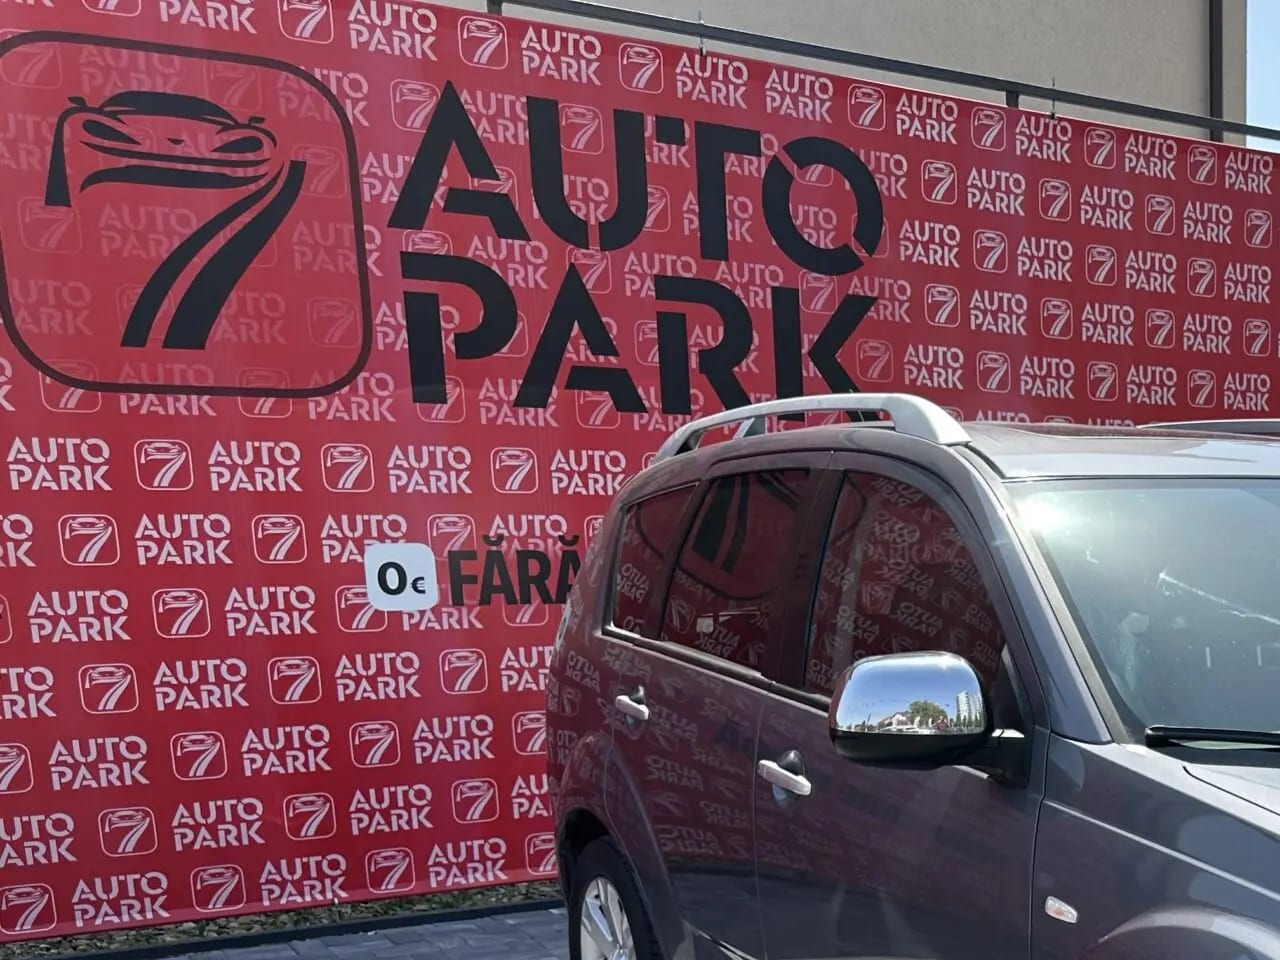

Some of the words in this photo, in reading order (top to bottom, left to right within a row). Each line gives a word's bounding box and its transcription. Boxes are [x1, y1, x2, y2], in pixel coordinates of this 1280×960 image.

[159, 0, 257, 34] PARK
[347, 0, 438, 33] AUTO
[349, 23, 437, 61] PARK
[521, 26, 601, 59] AUTO
[522, 50, 601, 85] PARK
[675, 52, 748, 84] AUTO
[676, 75, 747, 109] PARK
[765, 69, 833, 99] AUTO
[766, 91, 832, 123] PARK
[896, 92, 957, 122] AUTO
[896, 114, 957, 144] PARK
[1015, 114, 1072, 141] AUTO
[1016, 135, 1071, 163] PARK
[1124, 134, 1177, 159] AUTO
[849, 147, 908, 177] UTO
[1125, 153, 1176, 180] PARK
[1225, 154, 1272, 173] AUTO
[387, 80, 883, 275] AUTO
[967, 167, 1025, 194] AUTO
[1225, 169, 1272, 194] PARK
[968, 188, 1025, 216] PARK
[1080, 184, 1134, 210] AUTO
[1081, 205, 1133, 231] PARK
[1183, 200, 1233, 224] AUTO
[899, 220, 960, 246] AUTO
[1183, 219, 1231, 244] PARK
[467, 235, 549, 265] AUTO
[900, 241, 960, 268] PARK
[1017, 236, 1073, 260] AUTO
[623, 251, 698, 279] AUTO
[715, 260, 784, 288] AUTO
[1017, 256, 1072, 282] PARK
[1125, 250, 1177, 273] AUTO
[1224, 262, 1271, 284] AUTO
[1126, 269, 1175, 294] PARK
[1224, 281, 1270, 304] PARK
[861, 295, 912, 324] ARK
[969, 289, 1027, 314] AUTO
[1081, 302, 1134, 325] AUTO
[970, 309, 1027, 335] PARK
[1082, 322, 1133, 346] PARK
[1183, 313, 1232, 334] AUTO
[401, 250, 880, 422] PARK
[1183, 332, 1230, 354] PARK
[904, 344, 964, 368] AUTO
[1019, 355, 1075, 378] AUTO
[904, 365, 963, 390] PARK
[1020, 375, 1074, 399] PARK
[1126, 365, 1177, 386] AUTO
[1224, 373, 1270, 392] AUTO
[120, 393, 217, 417] PARK
[1127, 384, 1176, 406] PARK
[1224, 391, 1269, 411] PARK
[308, 396, 396, 422] PARK
[479, 400, 559, 428] PARK
[7, 437, 110, 463] AUTO
[208, 440, 300, 466] AUTO
[387, 445, 471, 469] AUTO
[550, 449, 626, 472] AUTO
[9, 464, 112, 490] PARK
[210, 466, 302, 491] PARK
[389, 469, 472, 493] PARK
[552, 472, 631, 496] PARK
[134, 513, 231, 538] AUTO
[320, 514, 407, 538] AUTO
[489, 514, 568, 538] AUTO
[137, 540, 233, 565] PARK
[28, 589, 128, 616] AUTO
[224, 585, 315, 611] AUTO
[30, 616, 131, 643] PARK
[226, 610, 317, 636] PARK
[402, 606, 484, 632] PARK
[153, 658, 247, 685] AUTO
[335, 651, 420, 677] AUTO
[500, 646, 553, 671] AUT
[155, 683, 249, 711] PARK
[336, 675, 421, 701] PARK
[241, 724, 330, 752] AUTO
[413, 715, 493, 740] AUTO
[48, 736, 147, 765] AUTO
[414, 732, 495, 764] PARK
[243, 748, 332, 776] PARK
[51, 761, 150, 790] PARK
[349, 784, 432, 812] AUTO
[172, 797, 263, 827] AUTO
[351, 803, 433, 835] PARK
[0, 813, 74, 841] UTO
[174, 821, 265, 851] PARK
[0, 837, 77, 868] ARK
[427, 838, 506, 865] AUTO
[259, 854, 346, 883] AUTO
[429, 857, 508, 888] PARK
[72, 872, 168, 903] AUTO
[261, 874, 349, 906] PARK
[74, 893, 171, 928] PARK
